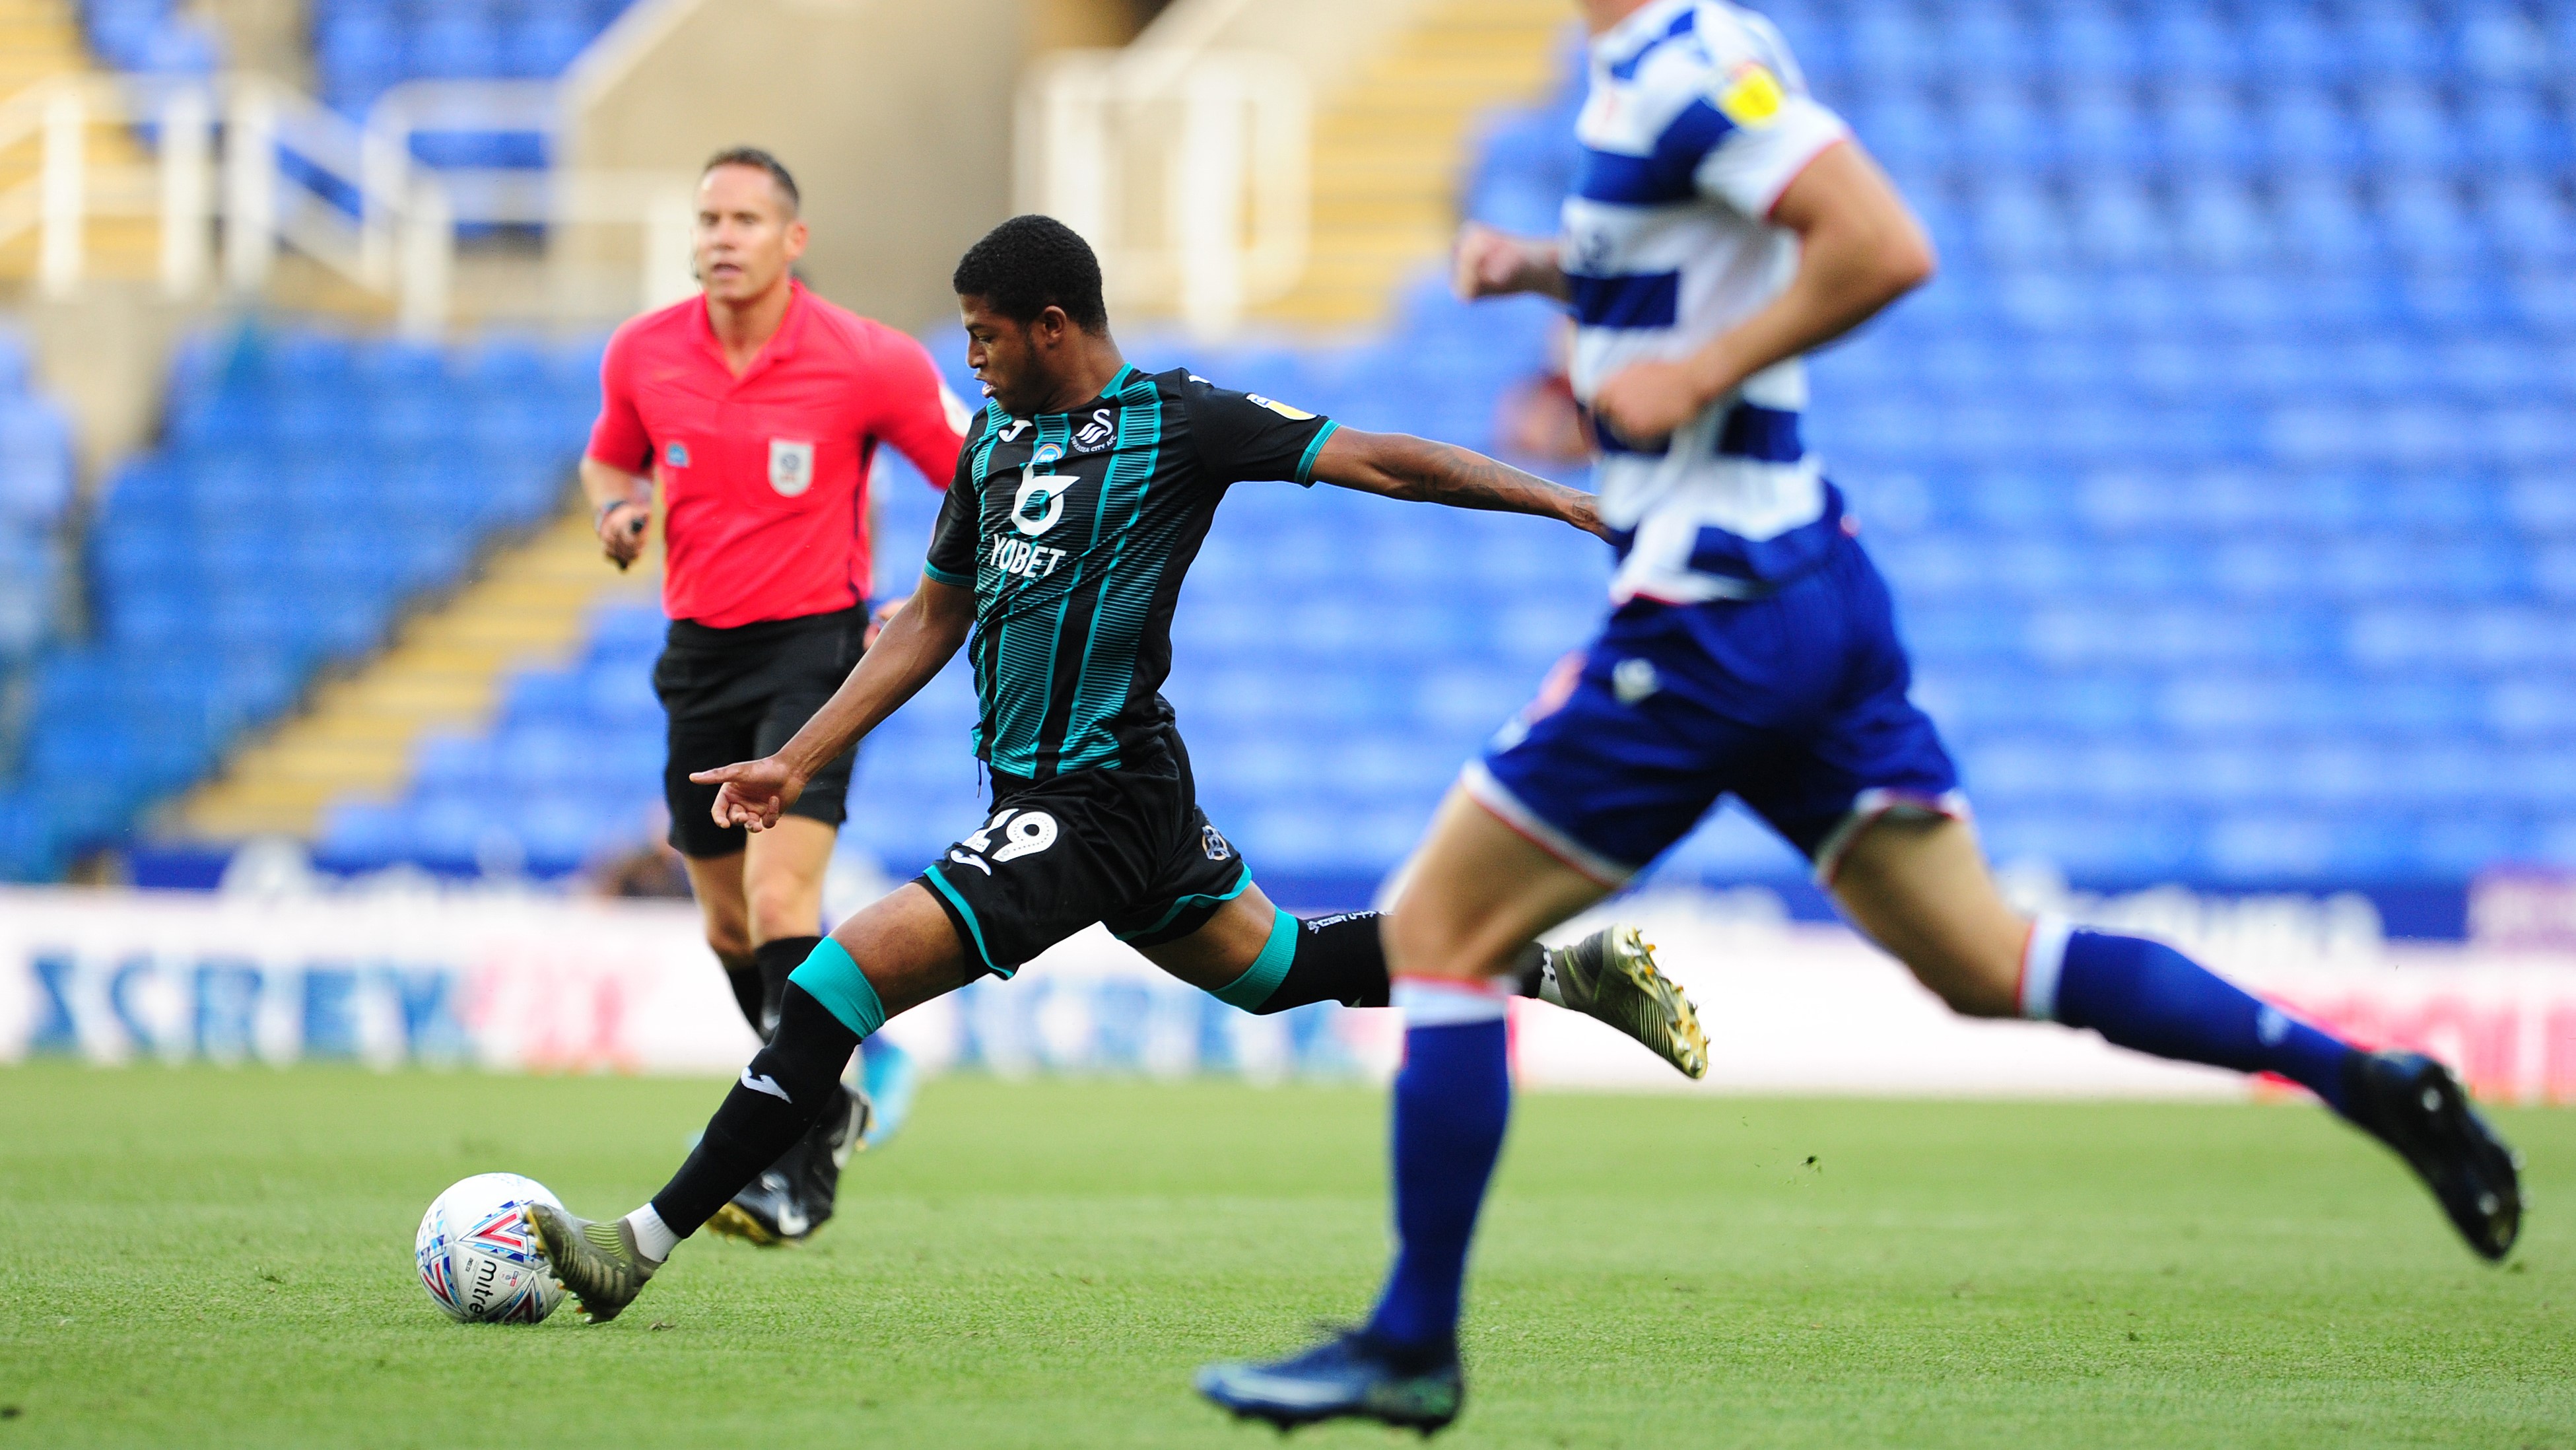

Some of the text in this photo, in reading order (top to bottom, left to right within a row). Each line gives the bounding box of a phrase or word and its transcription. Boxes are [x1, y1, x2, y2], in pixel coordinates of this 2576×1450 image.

[1070, 436, 1089, 452] SWANSEA
[1106, 435, 1117, 446] AFC
[990, 534, 1067, 578] YOBET
[962, 808, 1058, 862] 19
[469, 1260, 496, 1314] mitre
